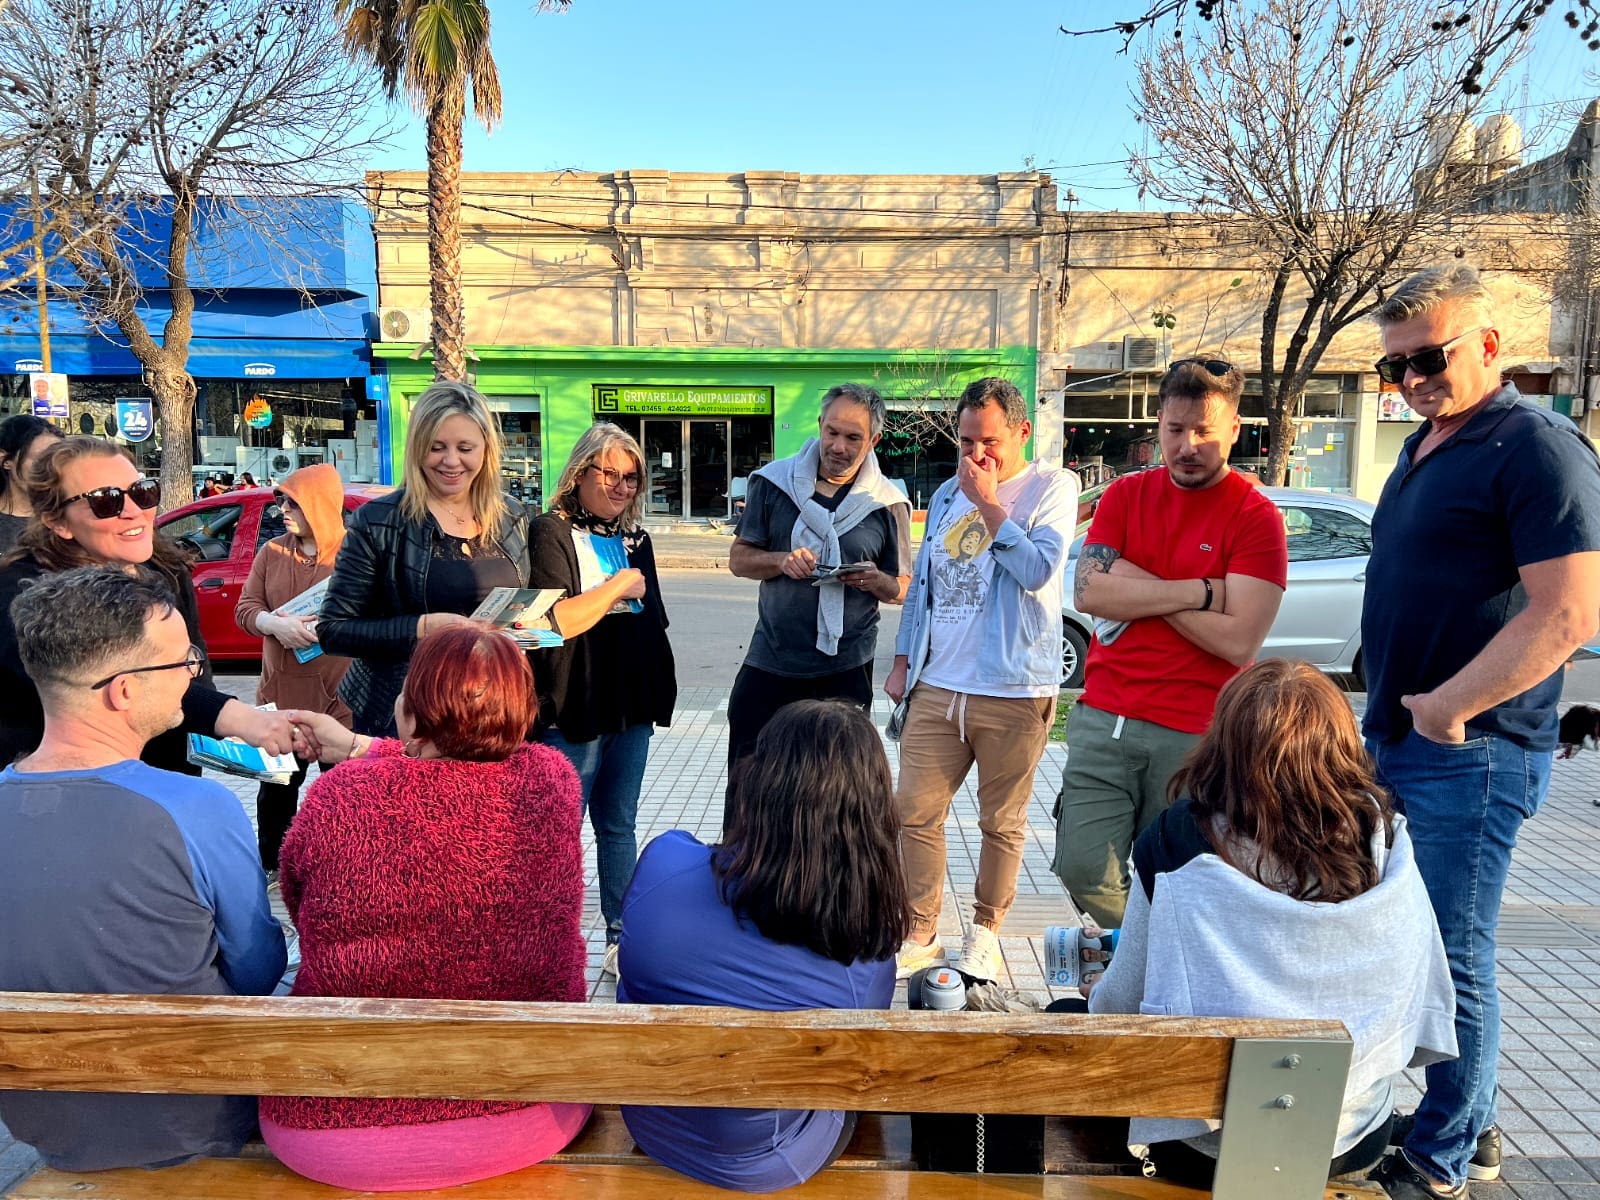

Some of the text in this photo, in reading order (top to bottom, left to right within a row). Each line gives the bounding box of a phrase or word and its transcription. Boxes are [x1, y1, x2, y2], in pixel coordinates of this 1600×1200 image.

[244, 367, 276, 376] PARDO
[624, 390, 766, 405] GRIVARELLO EQUIPAMIENTOS
